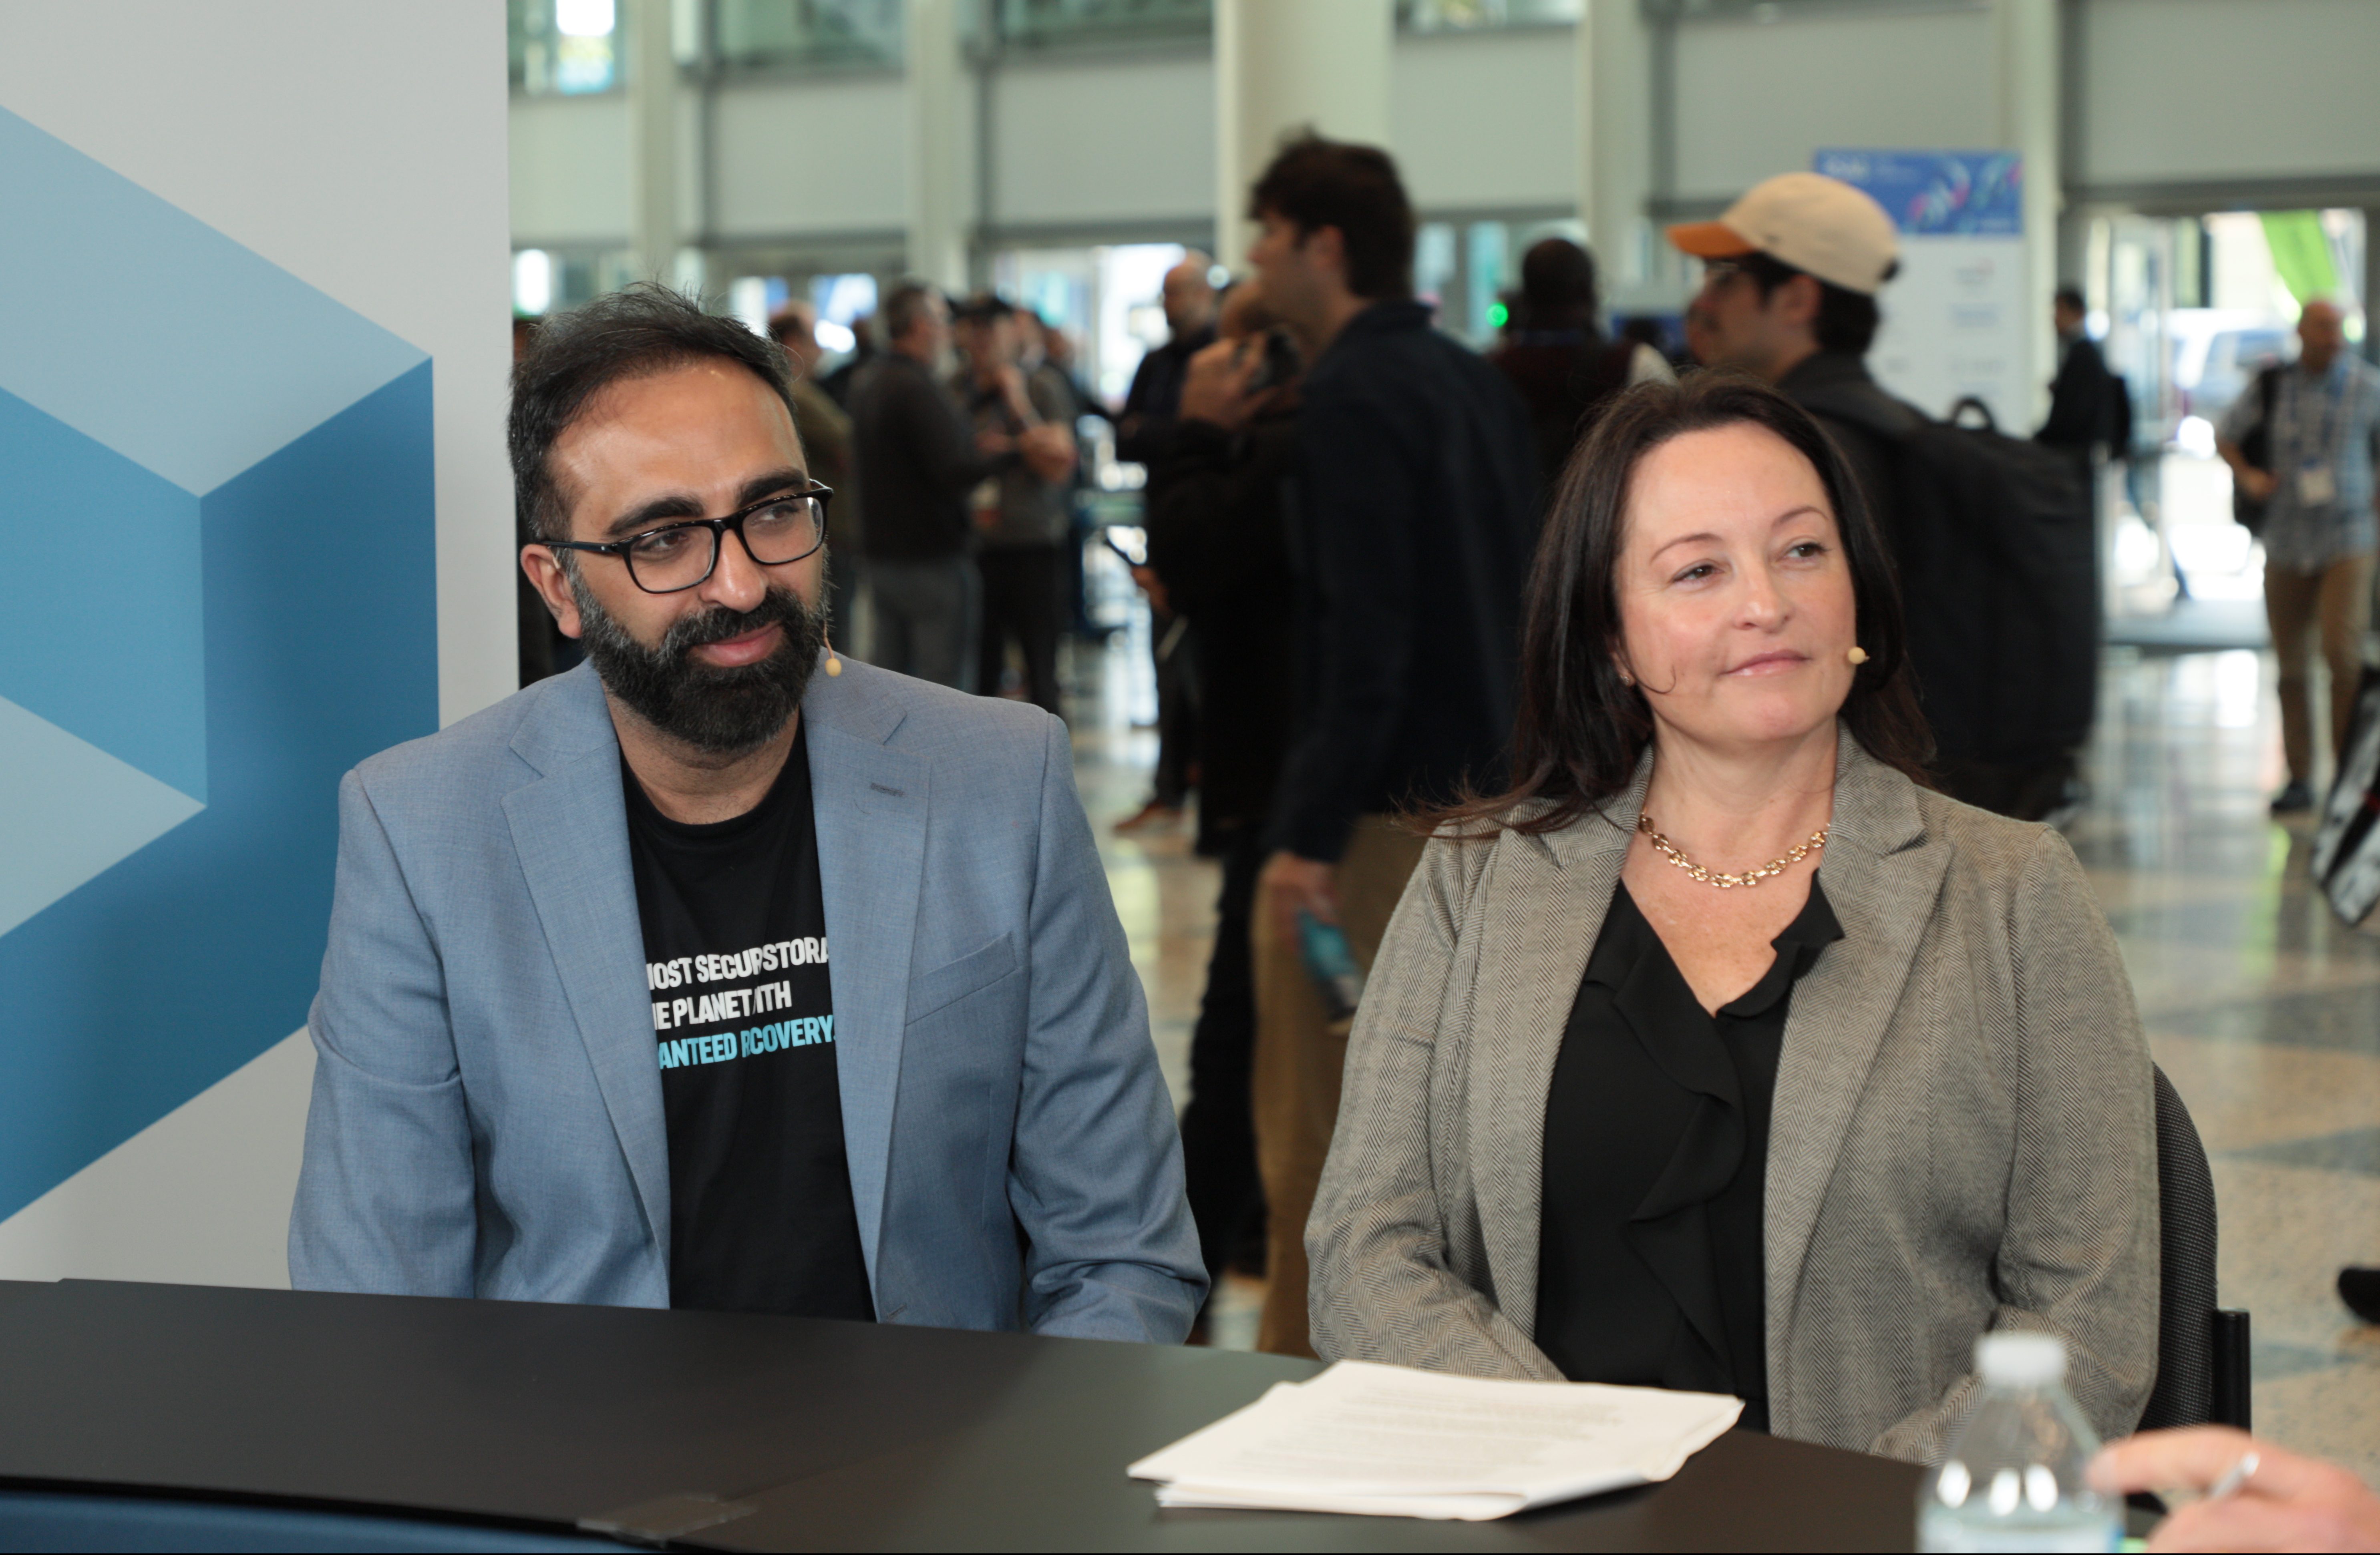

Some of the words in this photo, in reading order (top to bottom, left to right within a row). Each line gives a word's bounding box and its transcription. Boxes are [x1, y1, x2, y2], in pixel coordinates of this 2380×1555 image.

[695, 947, 762, 982] SECUR
[652, 1002, 671, 1030] E
[672, 989, 752, 1027] PLANET
[752, 980, 792, 1015] ITH
